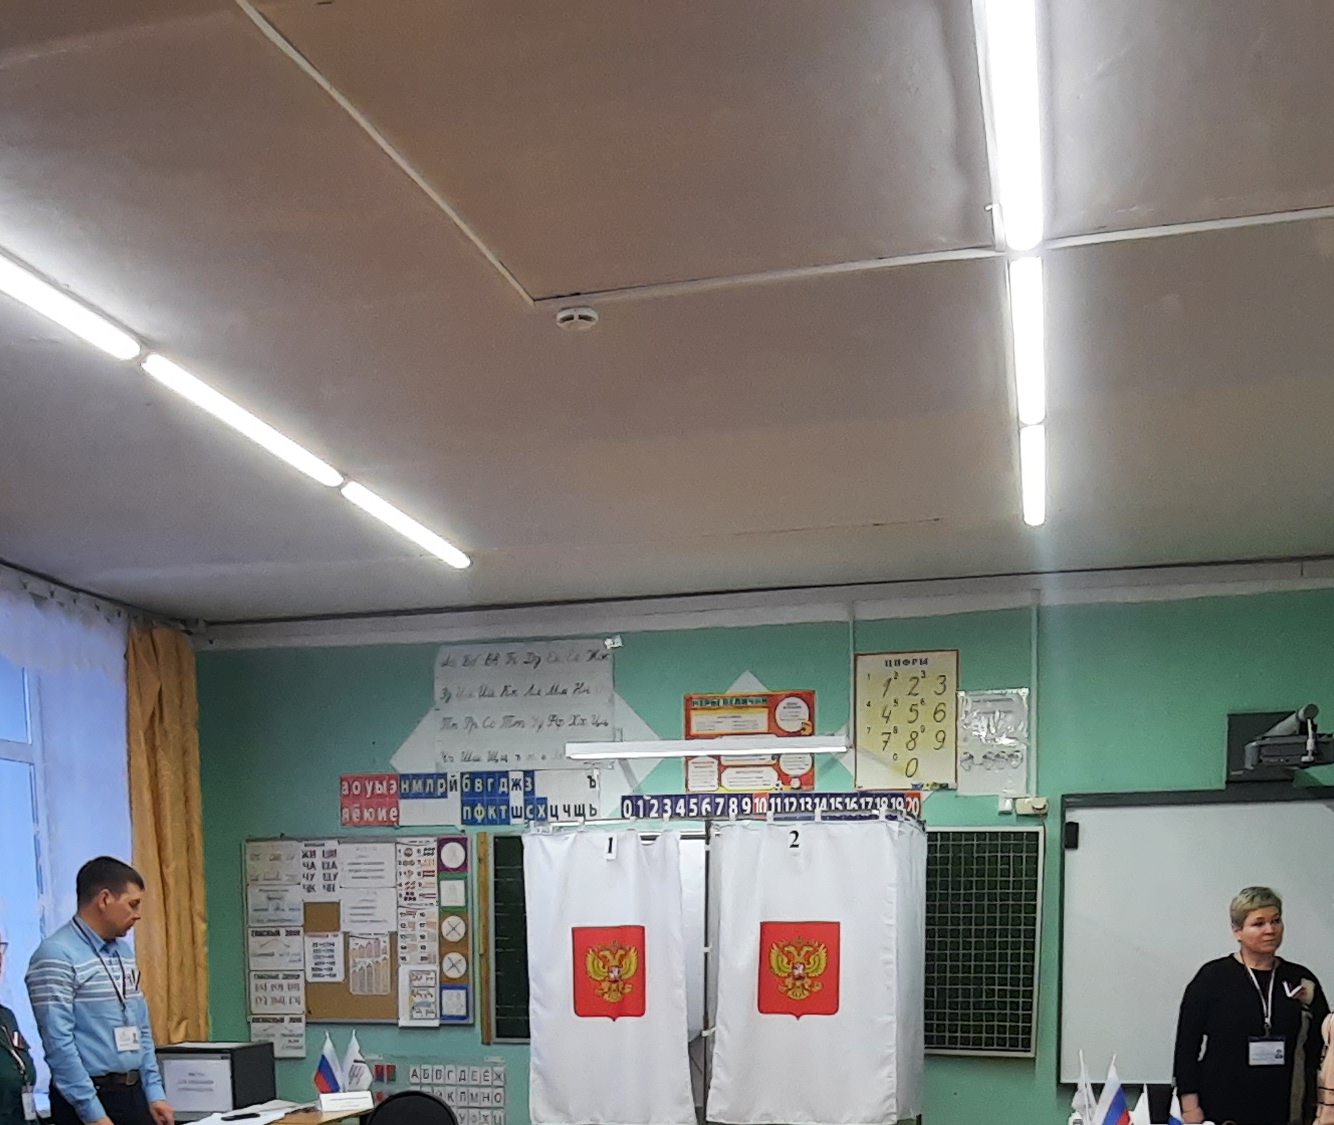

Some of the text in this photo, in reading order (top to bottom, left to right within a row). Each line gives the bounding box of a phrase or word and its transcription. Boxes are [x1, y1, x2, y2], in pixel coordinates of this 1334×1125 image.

[882, 675, 947, 698] 1 2 3
[881, 702, 946, 724] 4 5 6
[881, 729, 946, 751] 7 8 9
[905, 757, 919, 778] 0
[623, 799, 633, 818] 0
[636, 799, 644, 818] 1
[649, 798, 659, 818] 2
[662, 799, 672, 817] 3
[675, 799, 686, 817] 4
[689, 798, 698, 817] 5
[701, 798, 711, 816] 6
[715, 797, 725, 816] 7
[728, 797, 738, 815] 8
[741, 797, 752, 815] 9
[753, 797, 767, 813] 10
[769, 797, 781, 812] 11
[860, 797, 874, 811] 17
[607, 836, 614, 854] 1
[788, 830, 800, 848] 2
